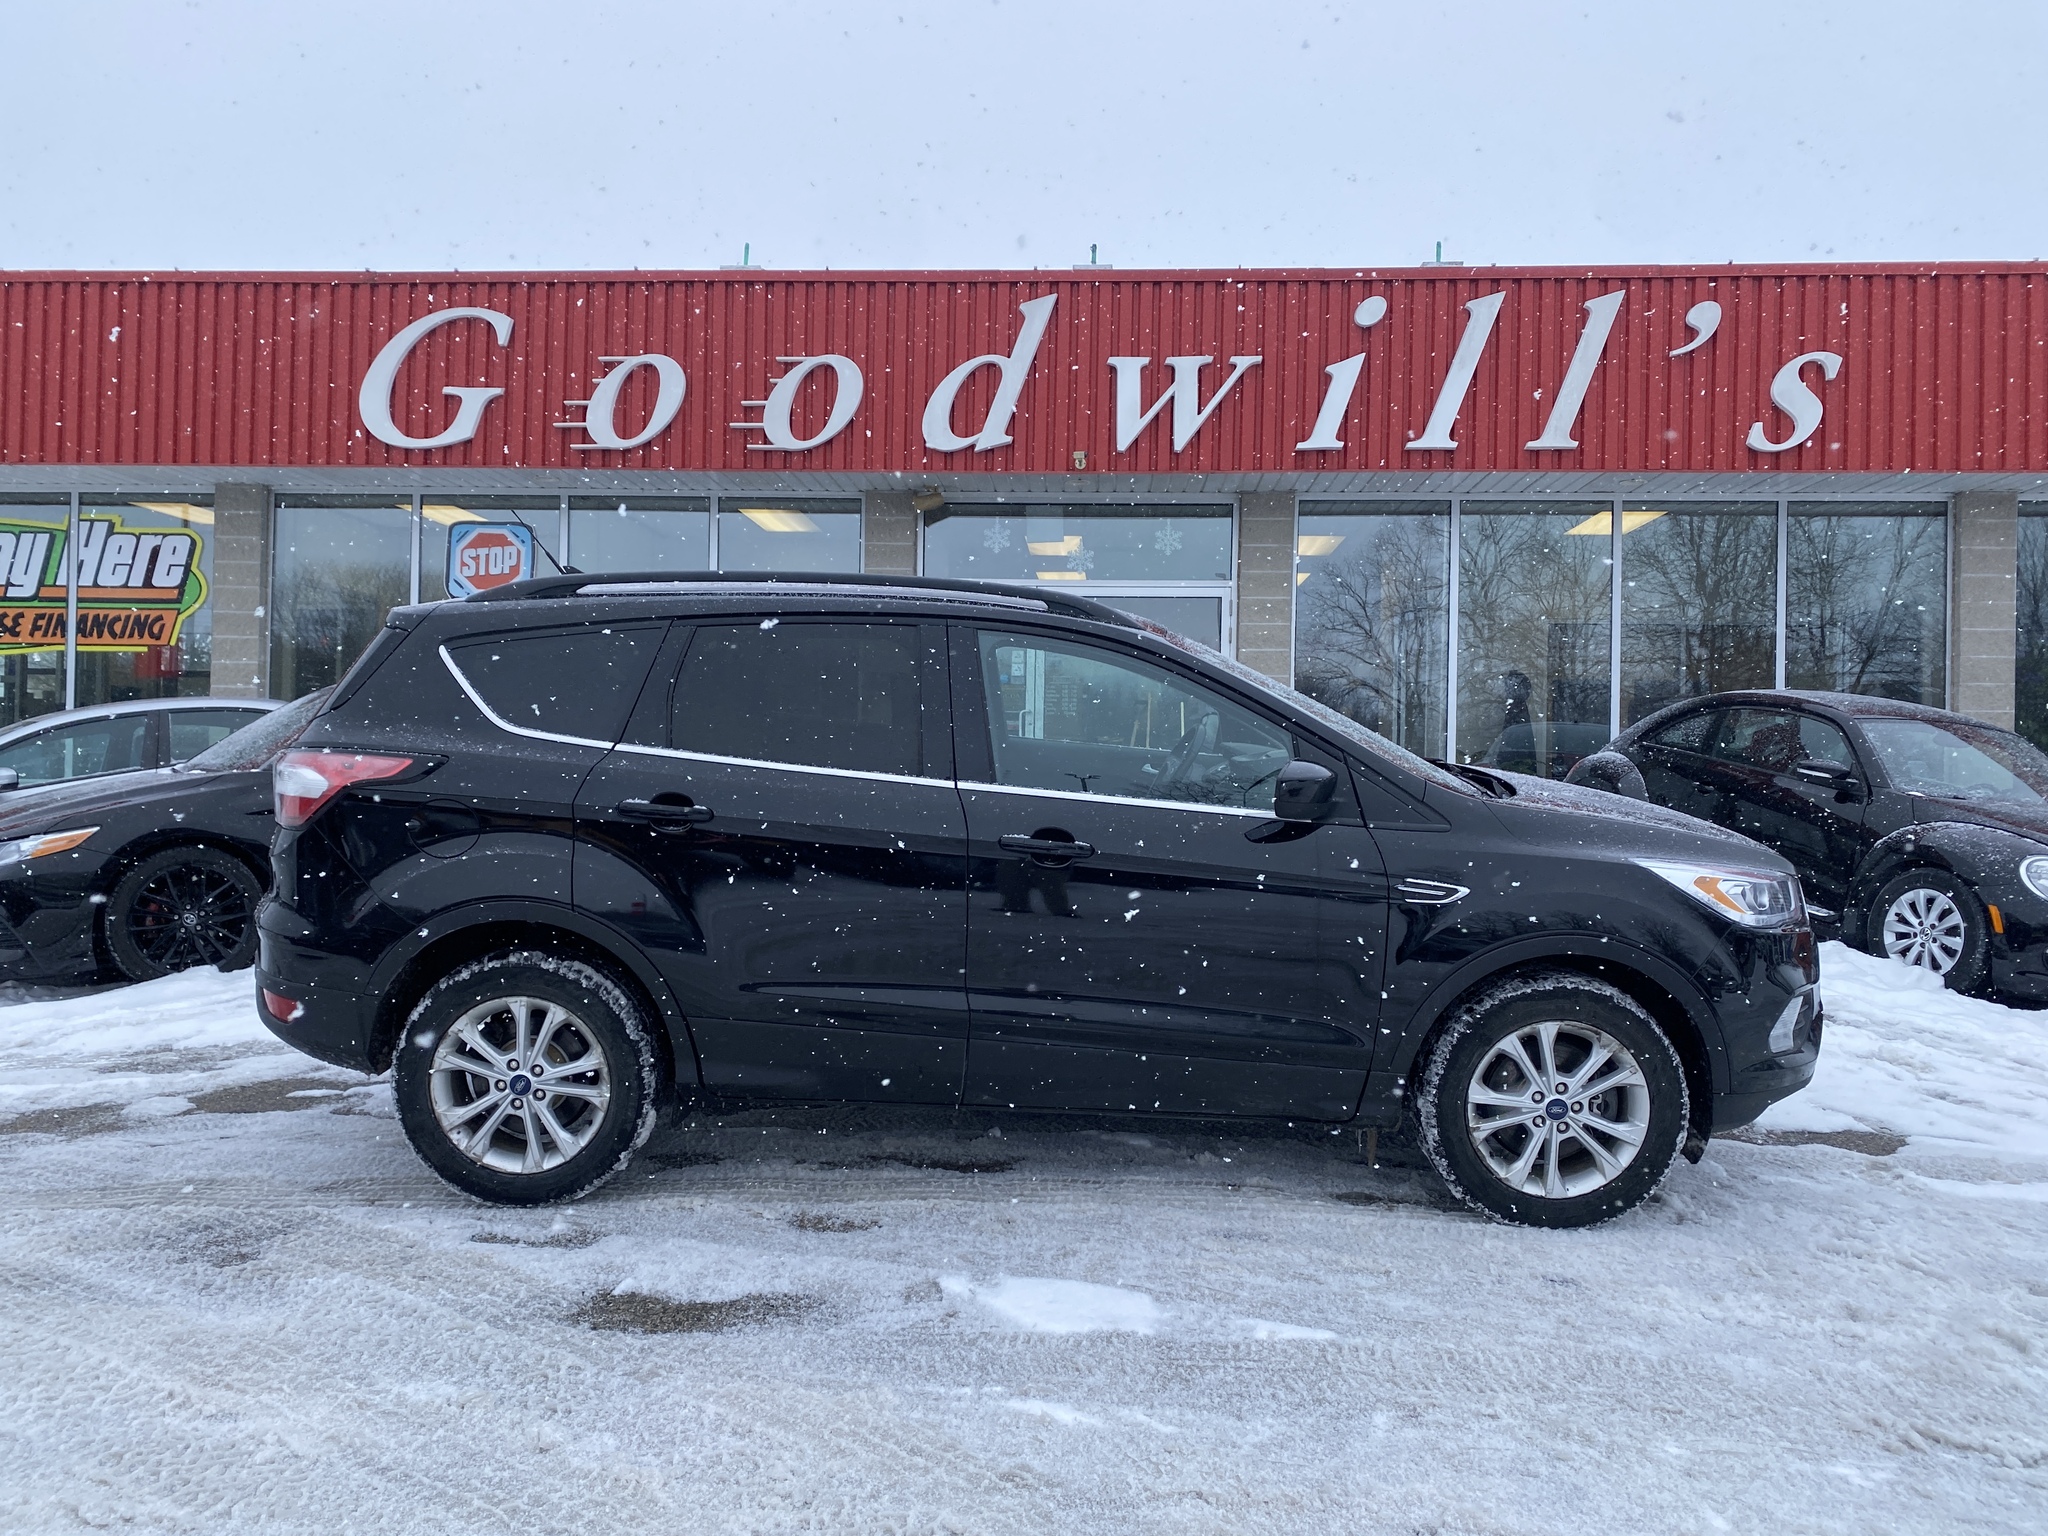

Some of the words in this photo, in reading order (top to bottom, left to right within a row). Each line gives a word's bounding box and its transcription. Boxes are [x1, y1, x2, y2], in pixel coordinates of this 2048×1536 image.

[359, 290, 1843, 453] Goodwill's
[55, 521, 191, 588] Here
[461, 545, 518, 577] STOP
[28, 612, 166, 641] FINANCING
